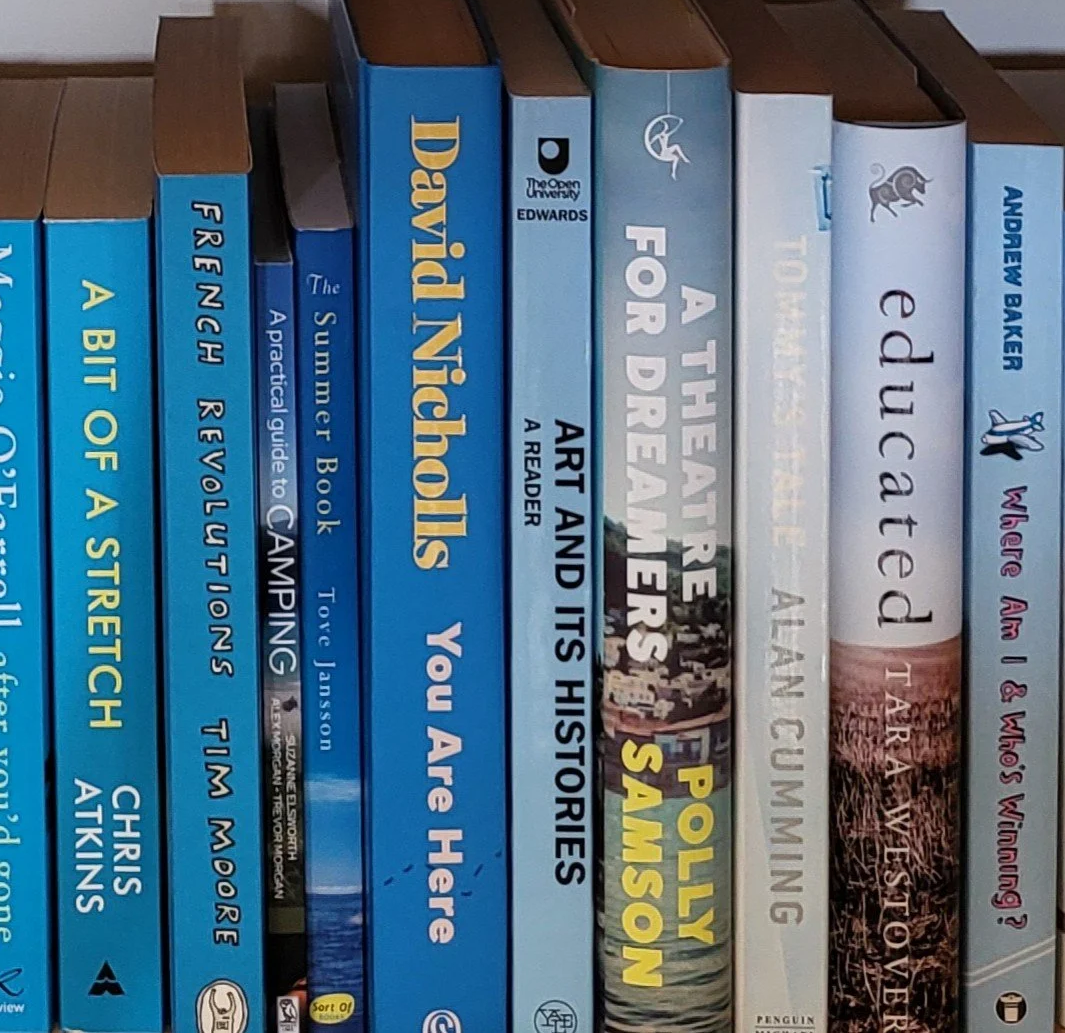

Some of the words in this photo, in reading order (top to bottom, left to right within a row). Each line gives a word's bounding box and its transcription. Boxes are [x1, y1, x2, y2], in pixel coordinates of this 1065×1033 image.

[411, 115, 464, 302] David
[516, 209, 588, 221] EDWARDS
[1003, 185, 1023, 286] ANDREW
[192, 200, 223, 365] FRENCH
[306, 273, 340, 295] The
[1003, 294, 1023, 371] BAKER
[312, 311, 336, 441] Summer
[316, 457, 340, 535] Book
[412, 312, 467, 570] Nicholls
[523, 441, 540, 527] READER
[555, 420, 584, 496] ART
[877, 288, 933, 627] educated
[198, 399, 233, 676] REVOLUTIONS
[266, 502, 297, 675] CAMPING
[553, 507, 585, 590] AND
[86, 537, 122, 729] STRETCH
[317, 587, 335, 647] Tove
[426, 622, 463, 711] You
[553, 605, 585, 663] ITS
[769, 588, 805, 698] ALAN
[202, 721, 231, 797] TIM
[313, 661, 333, 752] Jansson
[883, 664, 911, 779] TARA
[427, 726, 462, 812] Are
[553, 680, 585, 886] HISTORIES
[769, 718, 804, 925] CUMMING
[74, 778, 105, 914] ATKINS
[112, 785, 141, 895] CHRIS
[208, 819, 241, 946] MOORE
[428, 828, 463, 944] Here
[621, 740, 663, 988] SAMSON
[677, 764, 714, 945] POLLY
[992, 794, 1027, 931] Winning?
[882, 797, 912, 1032] WESTOVER
[756, 1015, 815, 1025] PENGUIN
